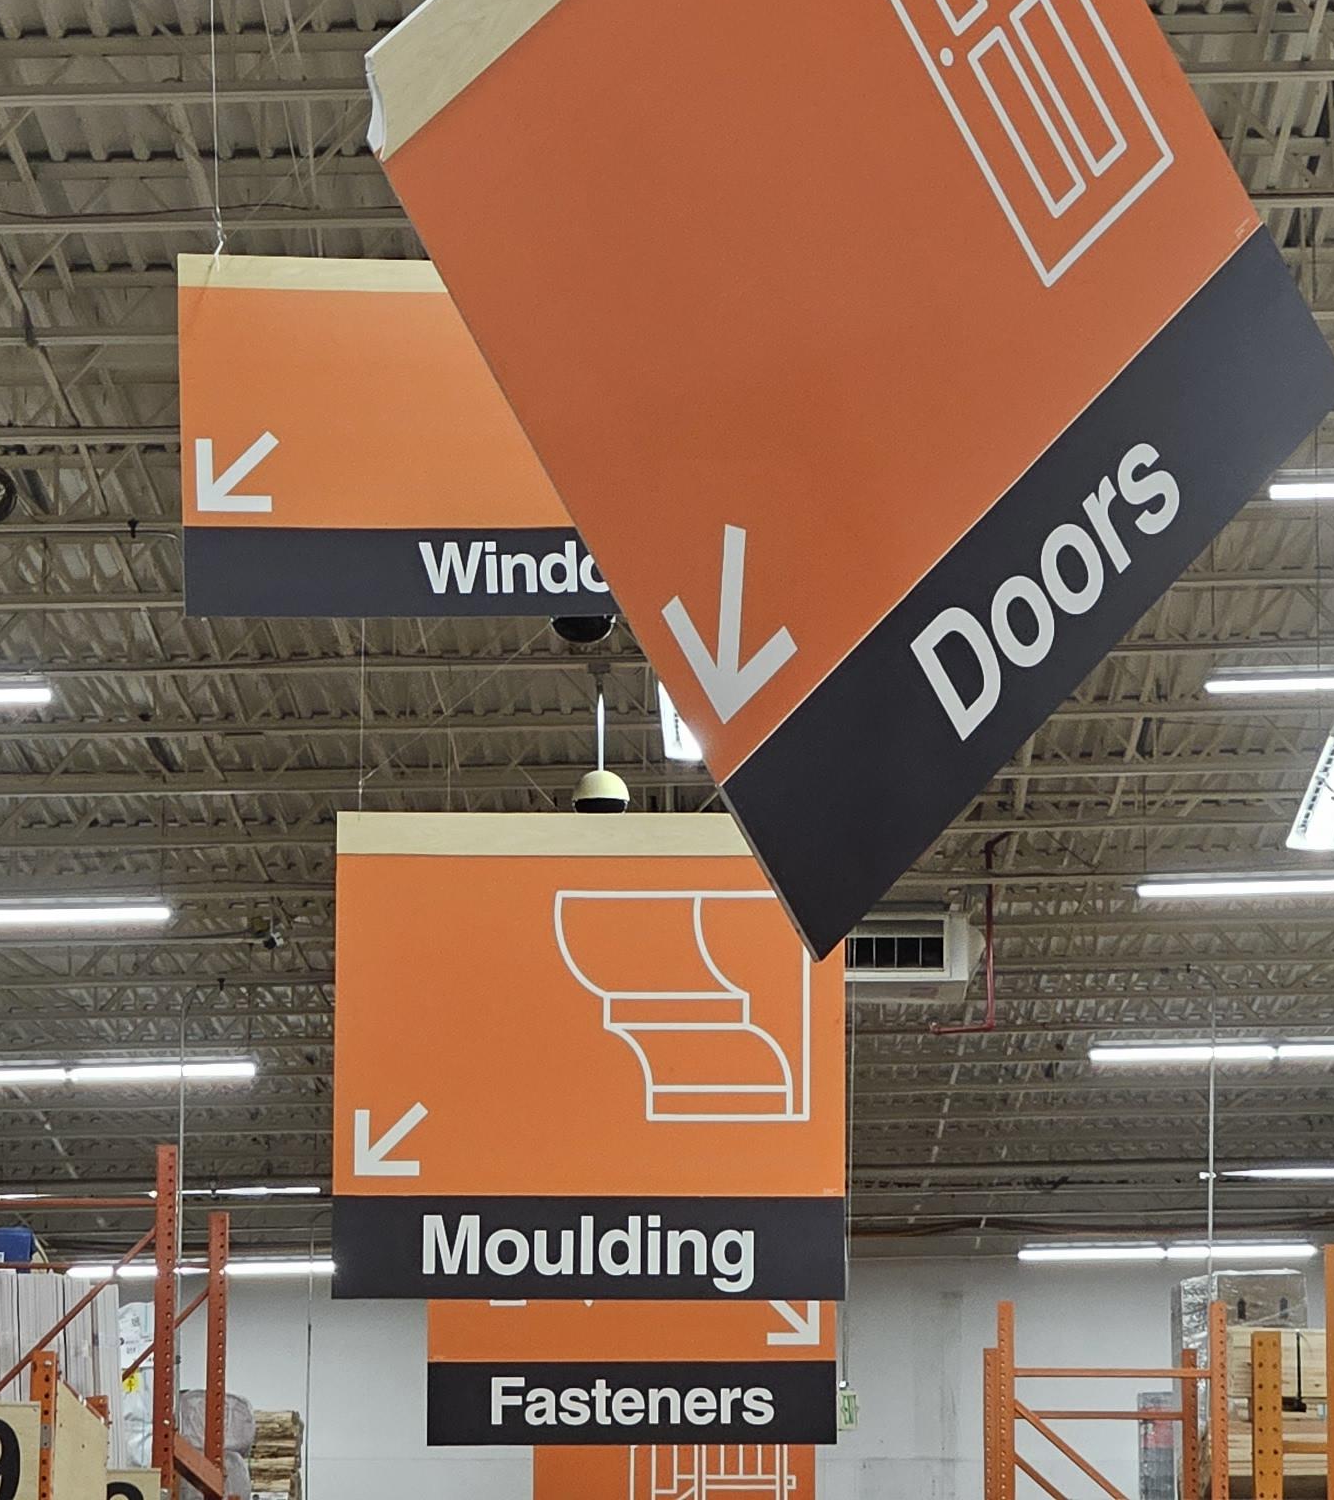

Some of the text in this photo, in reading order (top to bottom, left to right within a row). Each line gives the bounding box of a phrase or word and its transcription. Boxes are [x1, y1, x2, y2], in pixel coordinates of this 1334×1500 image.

[910, 443, 1180, 741] Doors
[421, 1214, 755, 1293] Moulding
[489, 1376, 775, 1426] Fasteners
